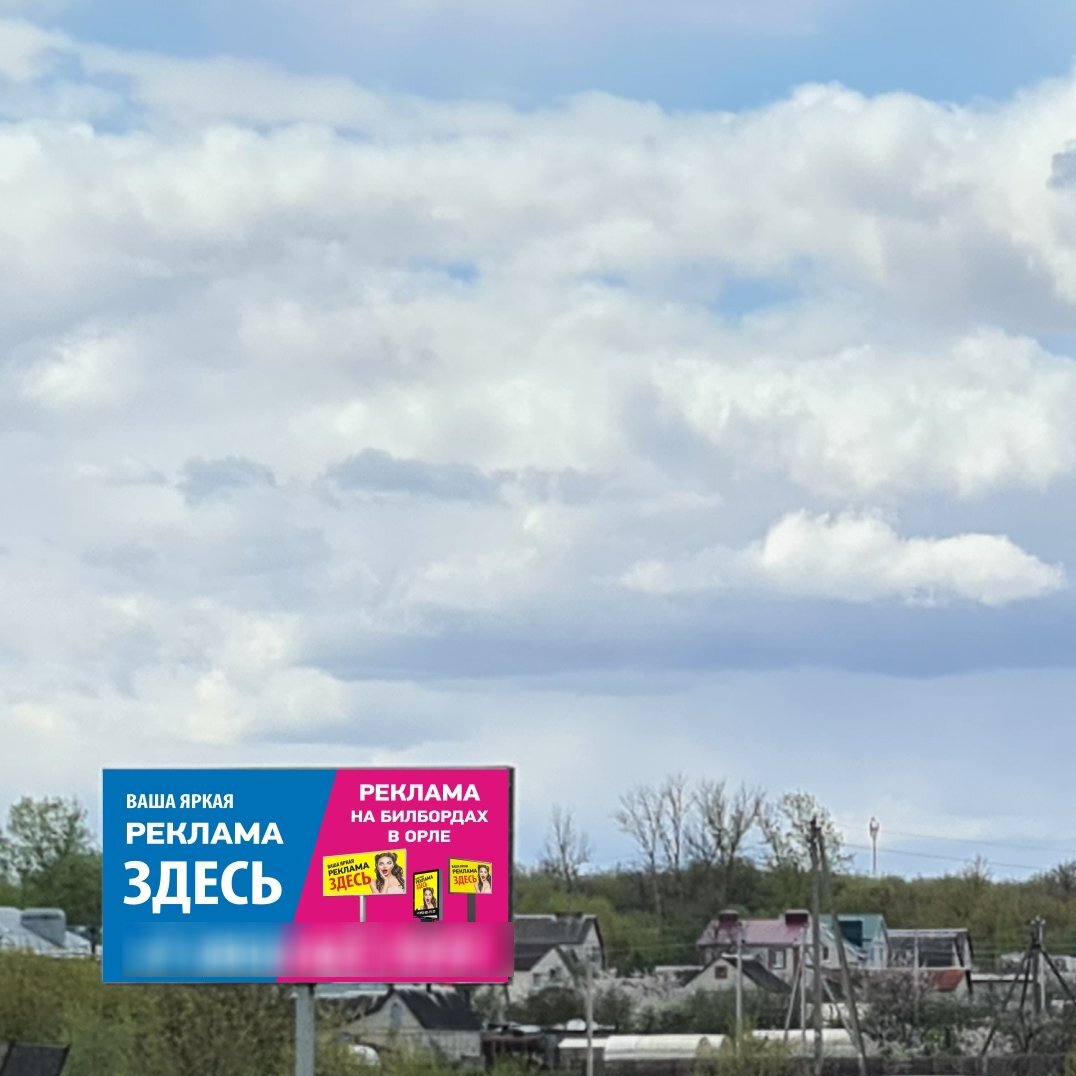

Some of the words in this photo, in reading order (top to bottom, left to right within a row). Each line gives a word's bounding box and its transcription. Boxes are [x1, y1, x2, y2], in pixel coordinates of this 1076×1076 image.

[126, 793, 177, 809] ВАША
[179, 793, 234, 809] ЯРКАЯ
[359, 783, 481, 802] РЕКЛАМА
[351, 809, 376, 823] НА
[380, 809, 489, 826] БИЛБОРДАХ
[126, 822, 284, 845] РЕКЛАМА
[387, 829, 400, 843] В
[404, 829, 452, 843] ОРЛЕ
[328, 862, 370, 877] РЕКЛАМА
[123, 860, 283, 914] ЗДЕСЬ
[329, 872, 372, 892] ЗДЕСЬ
[453, 875, 478, 886] ЗДЕСЬ
